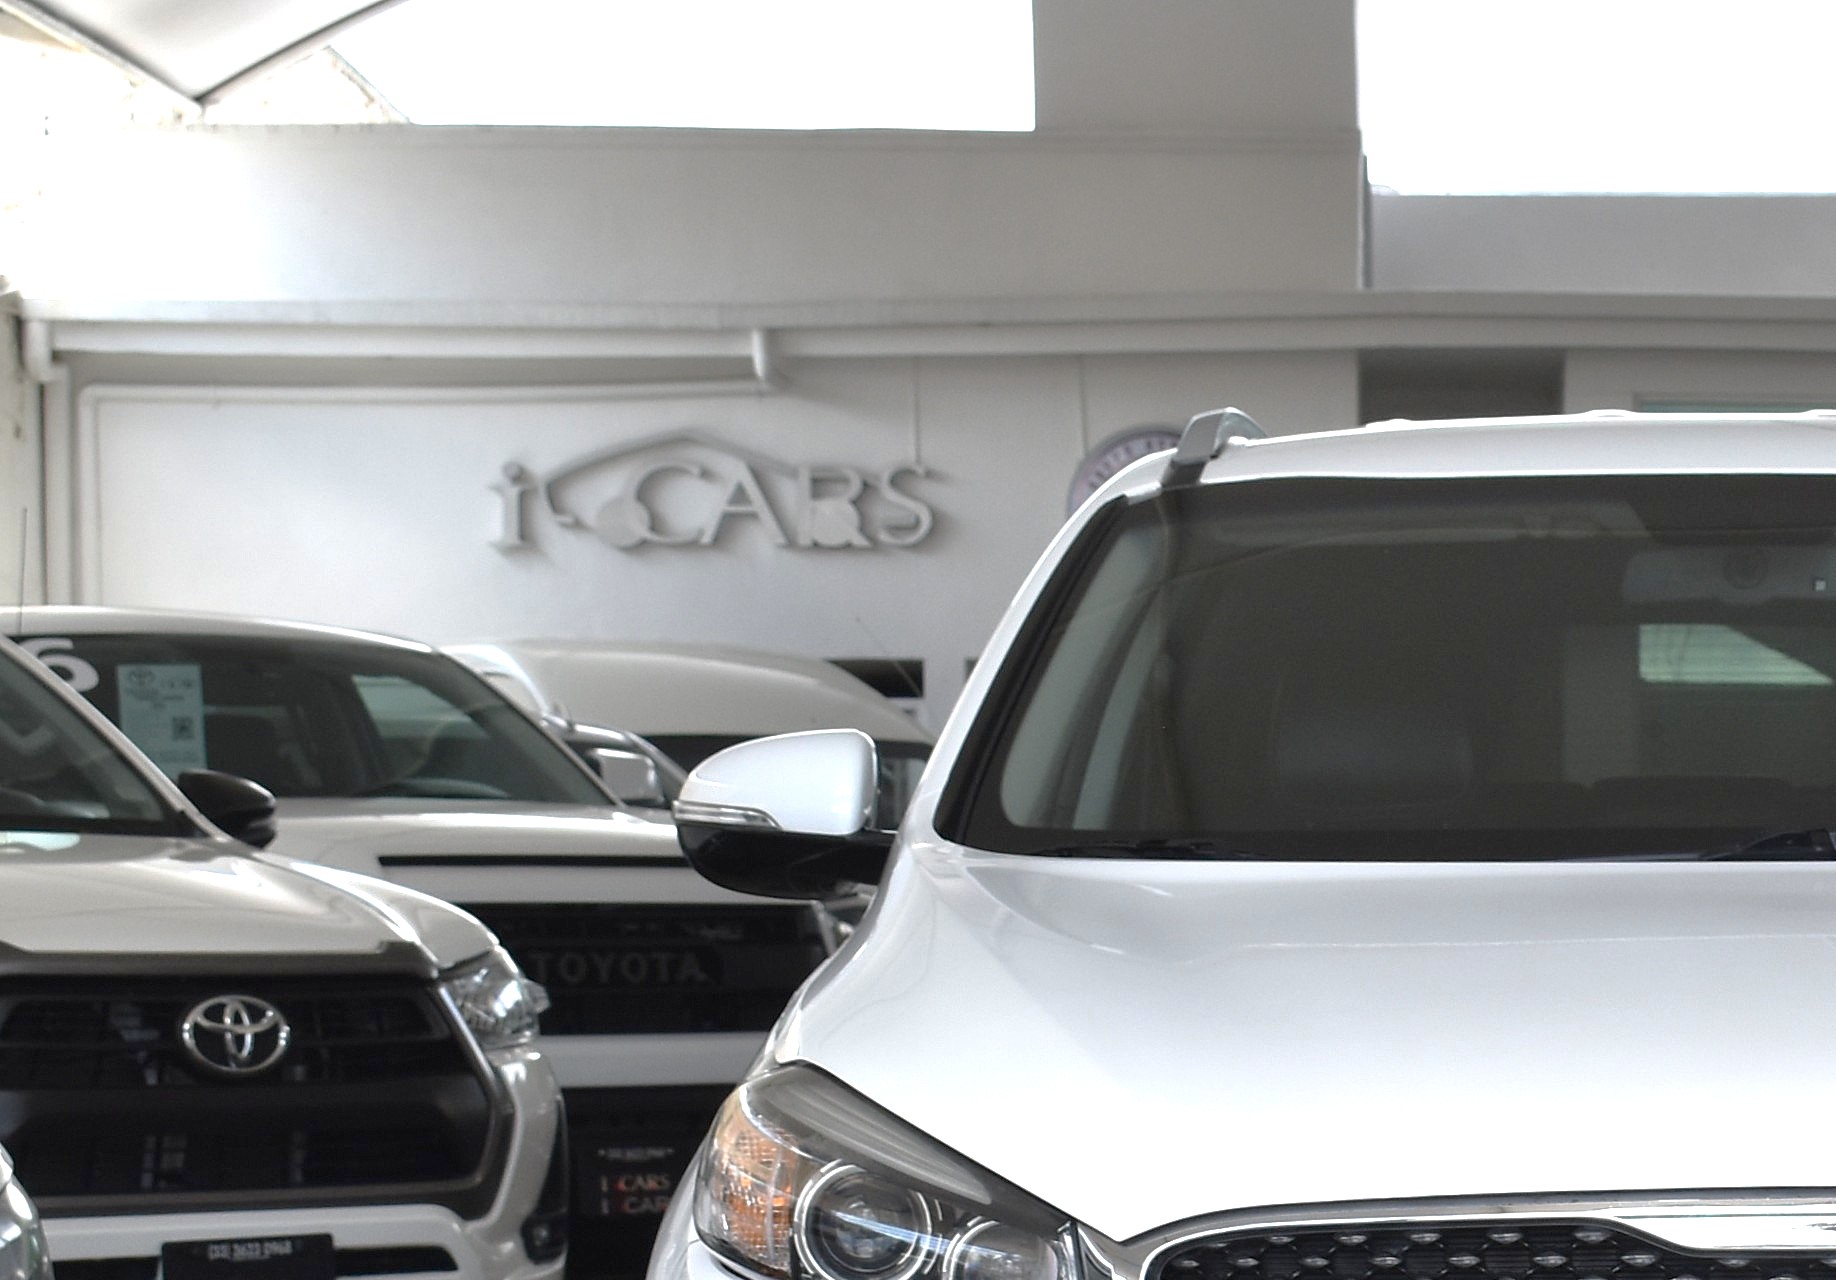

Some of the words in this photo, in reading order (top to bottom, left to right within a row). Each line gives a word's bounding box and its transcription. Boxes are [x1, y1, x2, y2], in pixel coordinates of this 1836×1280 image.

[486, 460, 535, 551] i
[628, 458, 937, 550] CARS
[528, 950, 710, 985] TOYOTA
